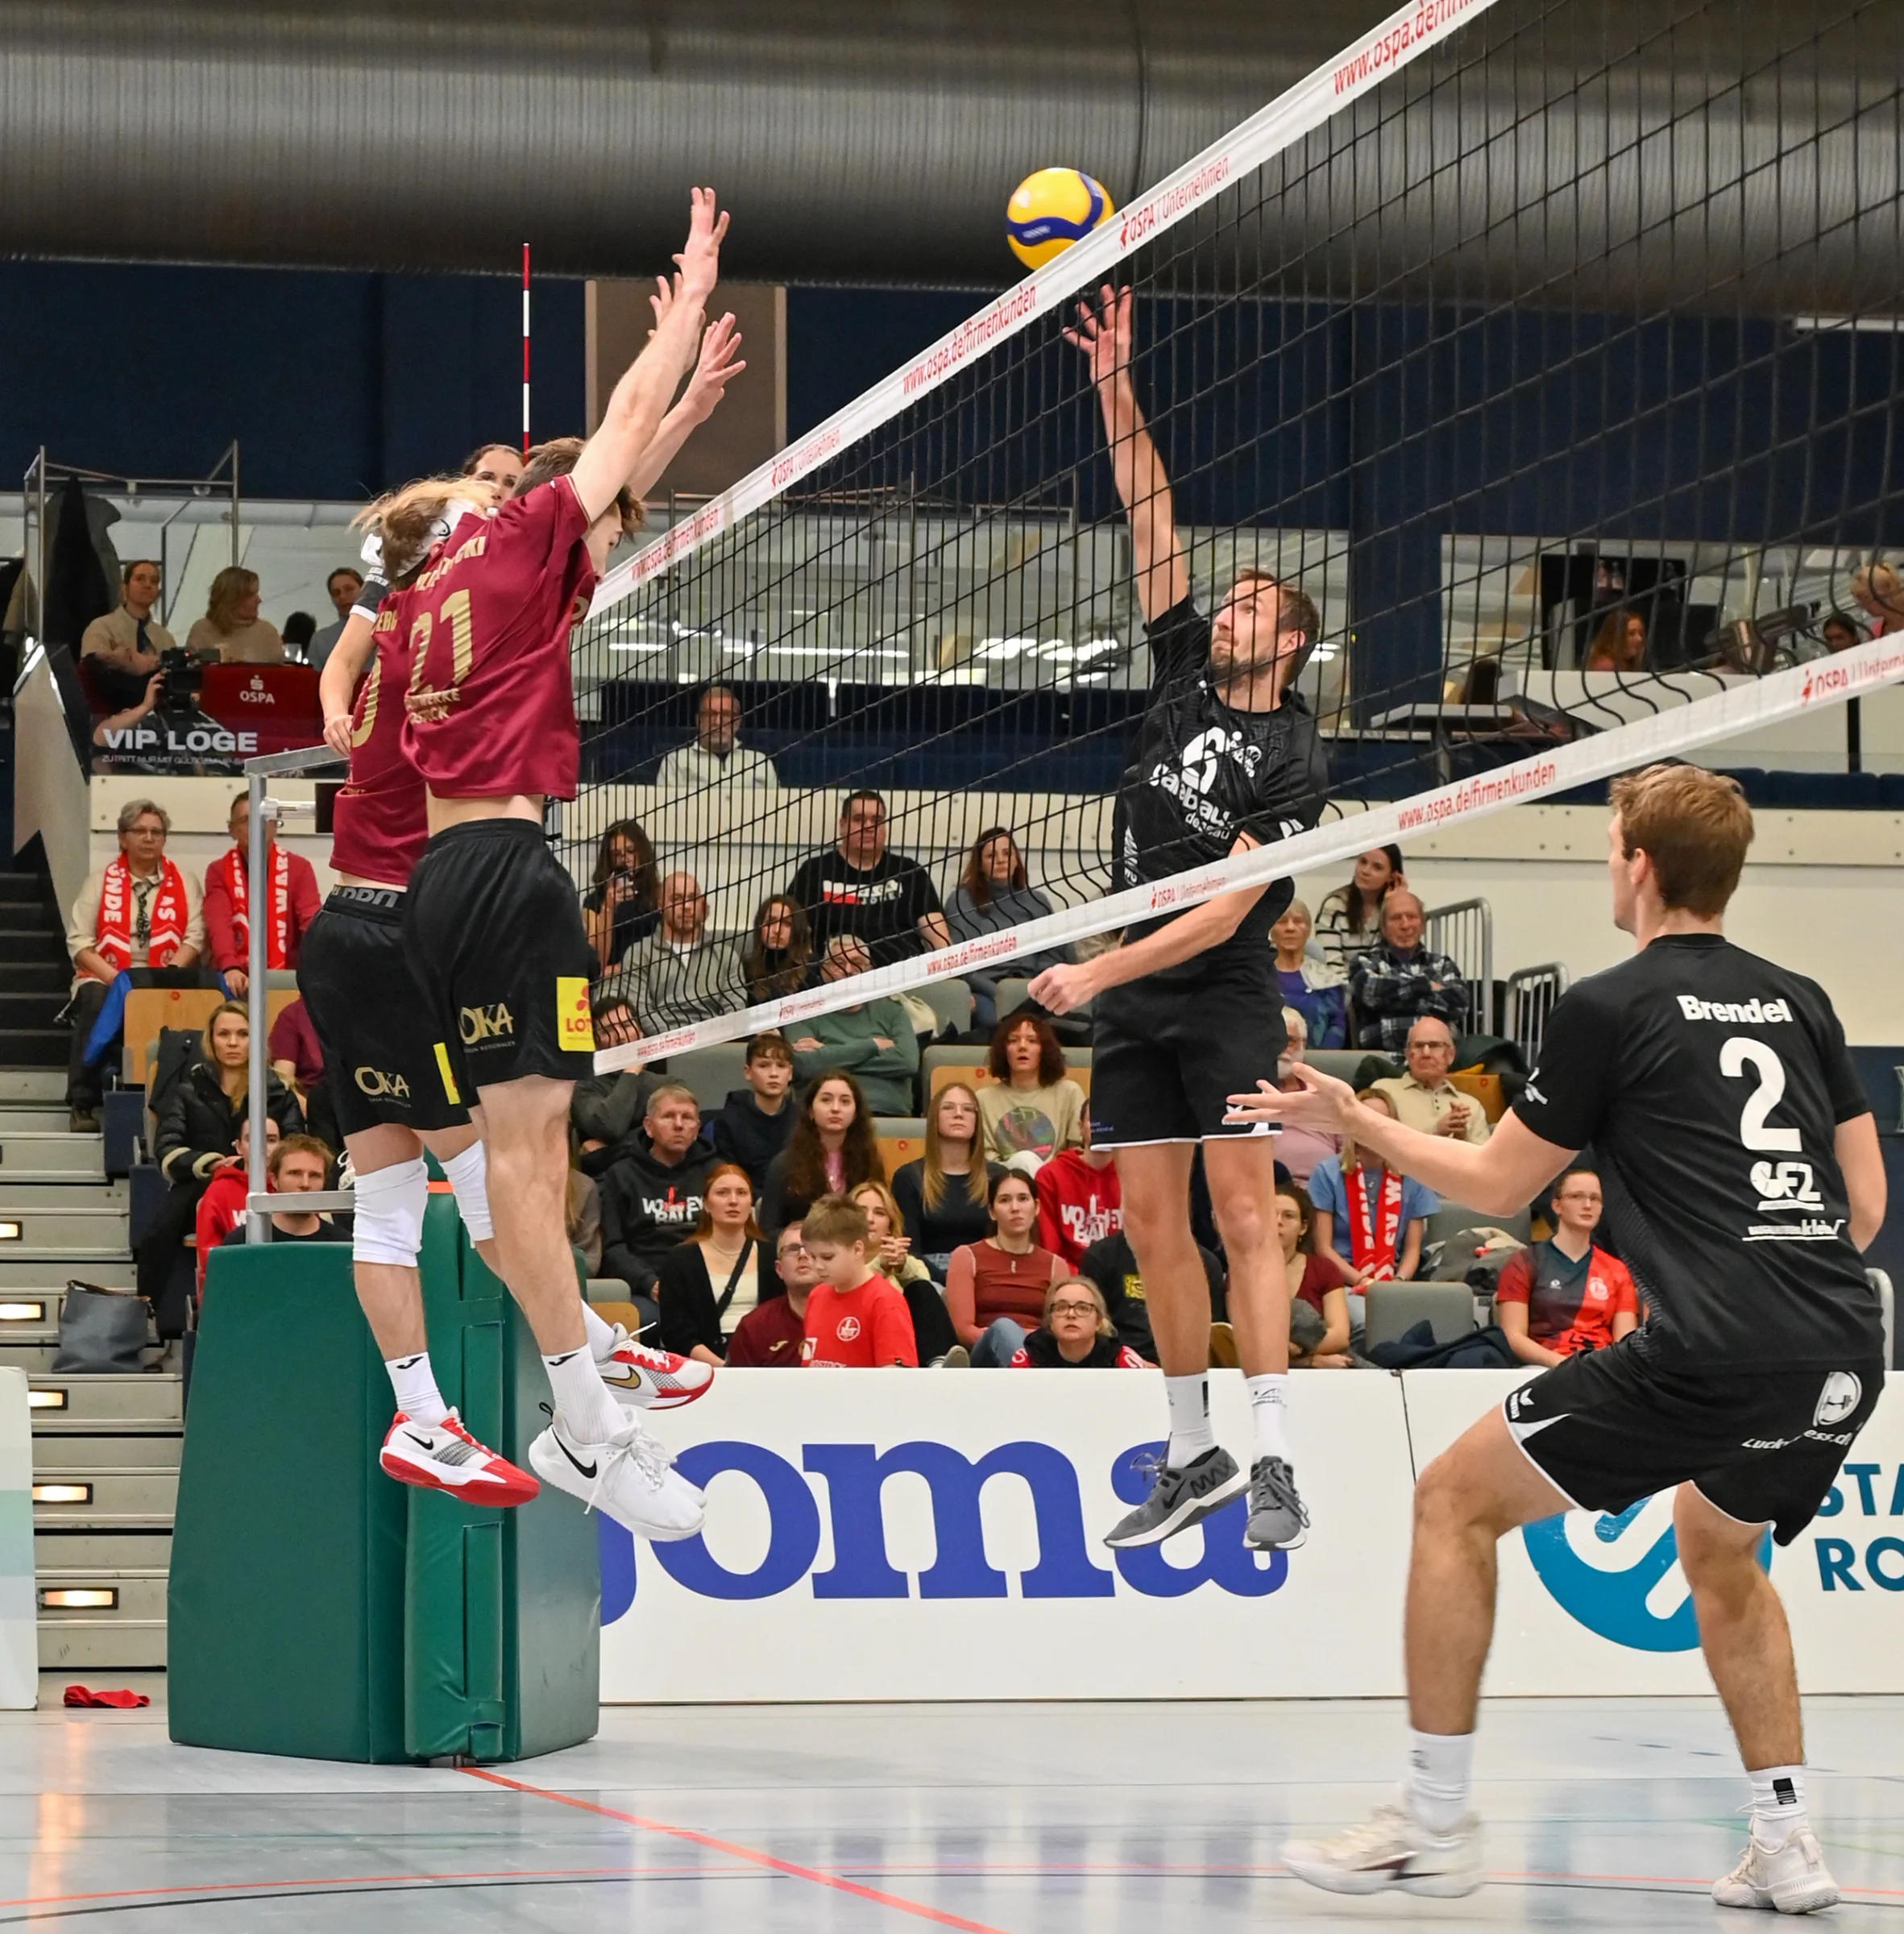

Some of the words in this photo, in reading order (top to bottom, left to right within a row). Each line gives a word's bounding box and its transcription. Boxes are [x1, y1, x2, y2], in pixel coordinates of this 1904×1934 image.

[1130, 204, 1155, 241] OSPA
[1163, 156, 1229, 218] Unternehmen
[409, 589, 473, 692] 21
[239, 691, 275, 704] OSPA
[102, 728, 156, 749] VIP
[168, 730, 257, 752] LOGE
[1398, 760, 1555, 830] www.ospa.de/firmenkunden
[104, 861, 127, 923] ÜNDE
[460, 1002, 513, 1044] OKA
[1677, 994, 1794, 1023] Brendel
[355, 1067, 410, 1098] OKA
[1719, 1037, 1802, 1152] 2
